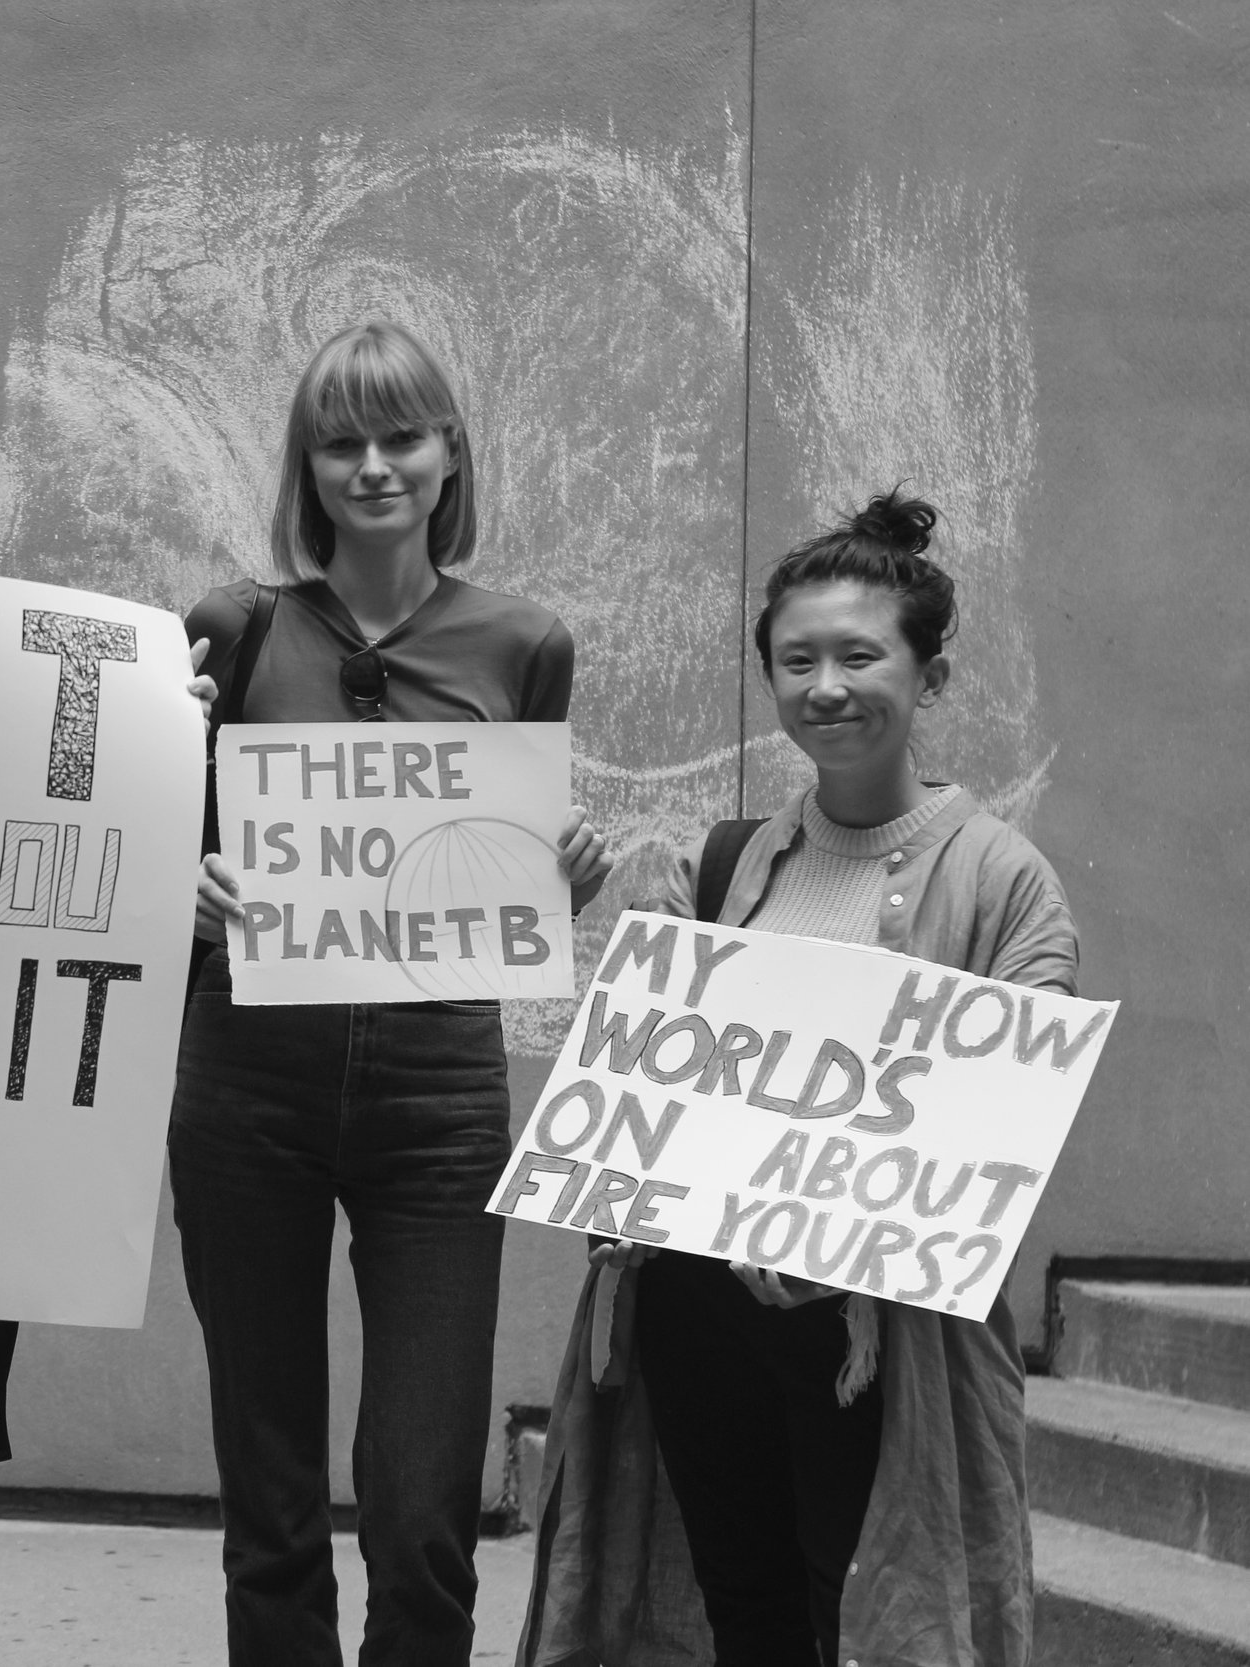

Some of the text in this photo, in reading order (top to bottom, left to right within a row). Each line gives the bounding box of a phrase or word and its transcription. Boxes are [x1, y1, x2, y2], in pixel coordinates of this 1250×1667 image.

[239, 741, 472, 799] THERE
[243, 820, 396, 878] IS NO
[241, 901, 551, 966] PLANET B
[598, 920, 747, 1008] MY
[5, 958, 143, 1107] IT
[578, 991, 933, 1137] WORLD'S
[880, 969, 1114, 1075] HOW
[535, 1079, 687, 1171] ON
[495, 1151, 691, 1244] FIRE
[749, 1129, 1044, 1229] ABOUT
[710, 1192, 1003, 1312] YOURS?
